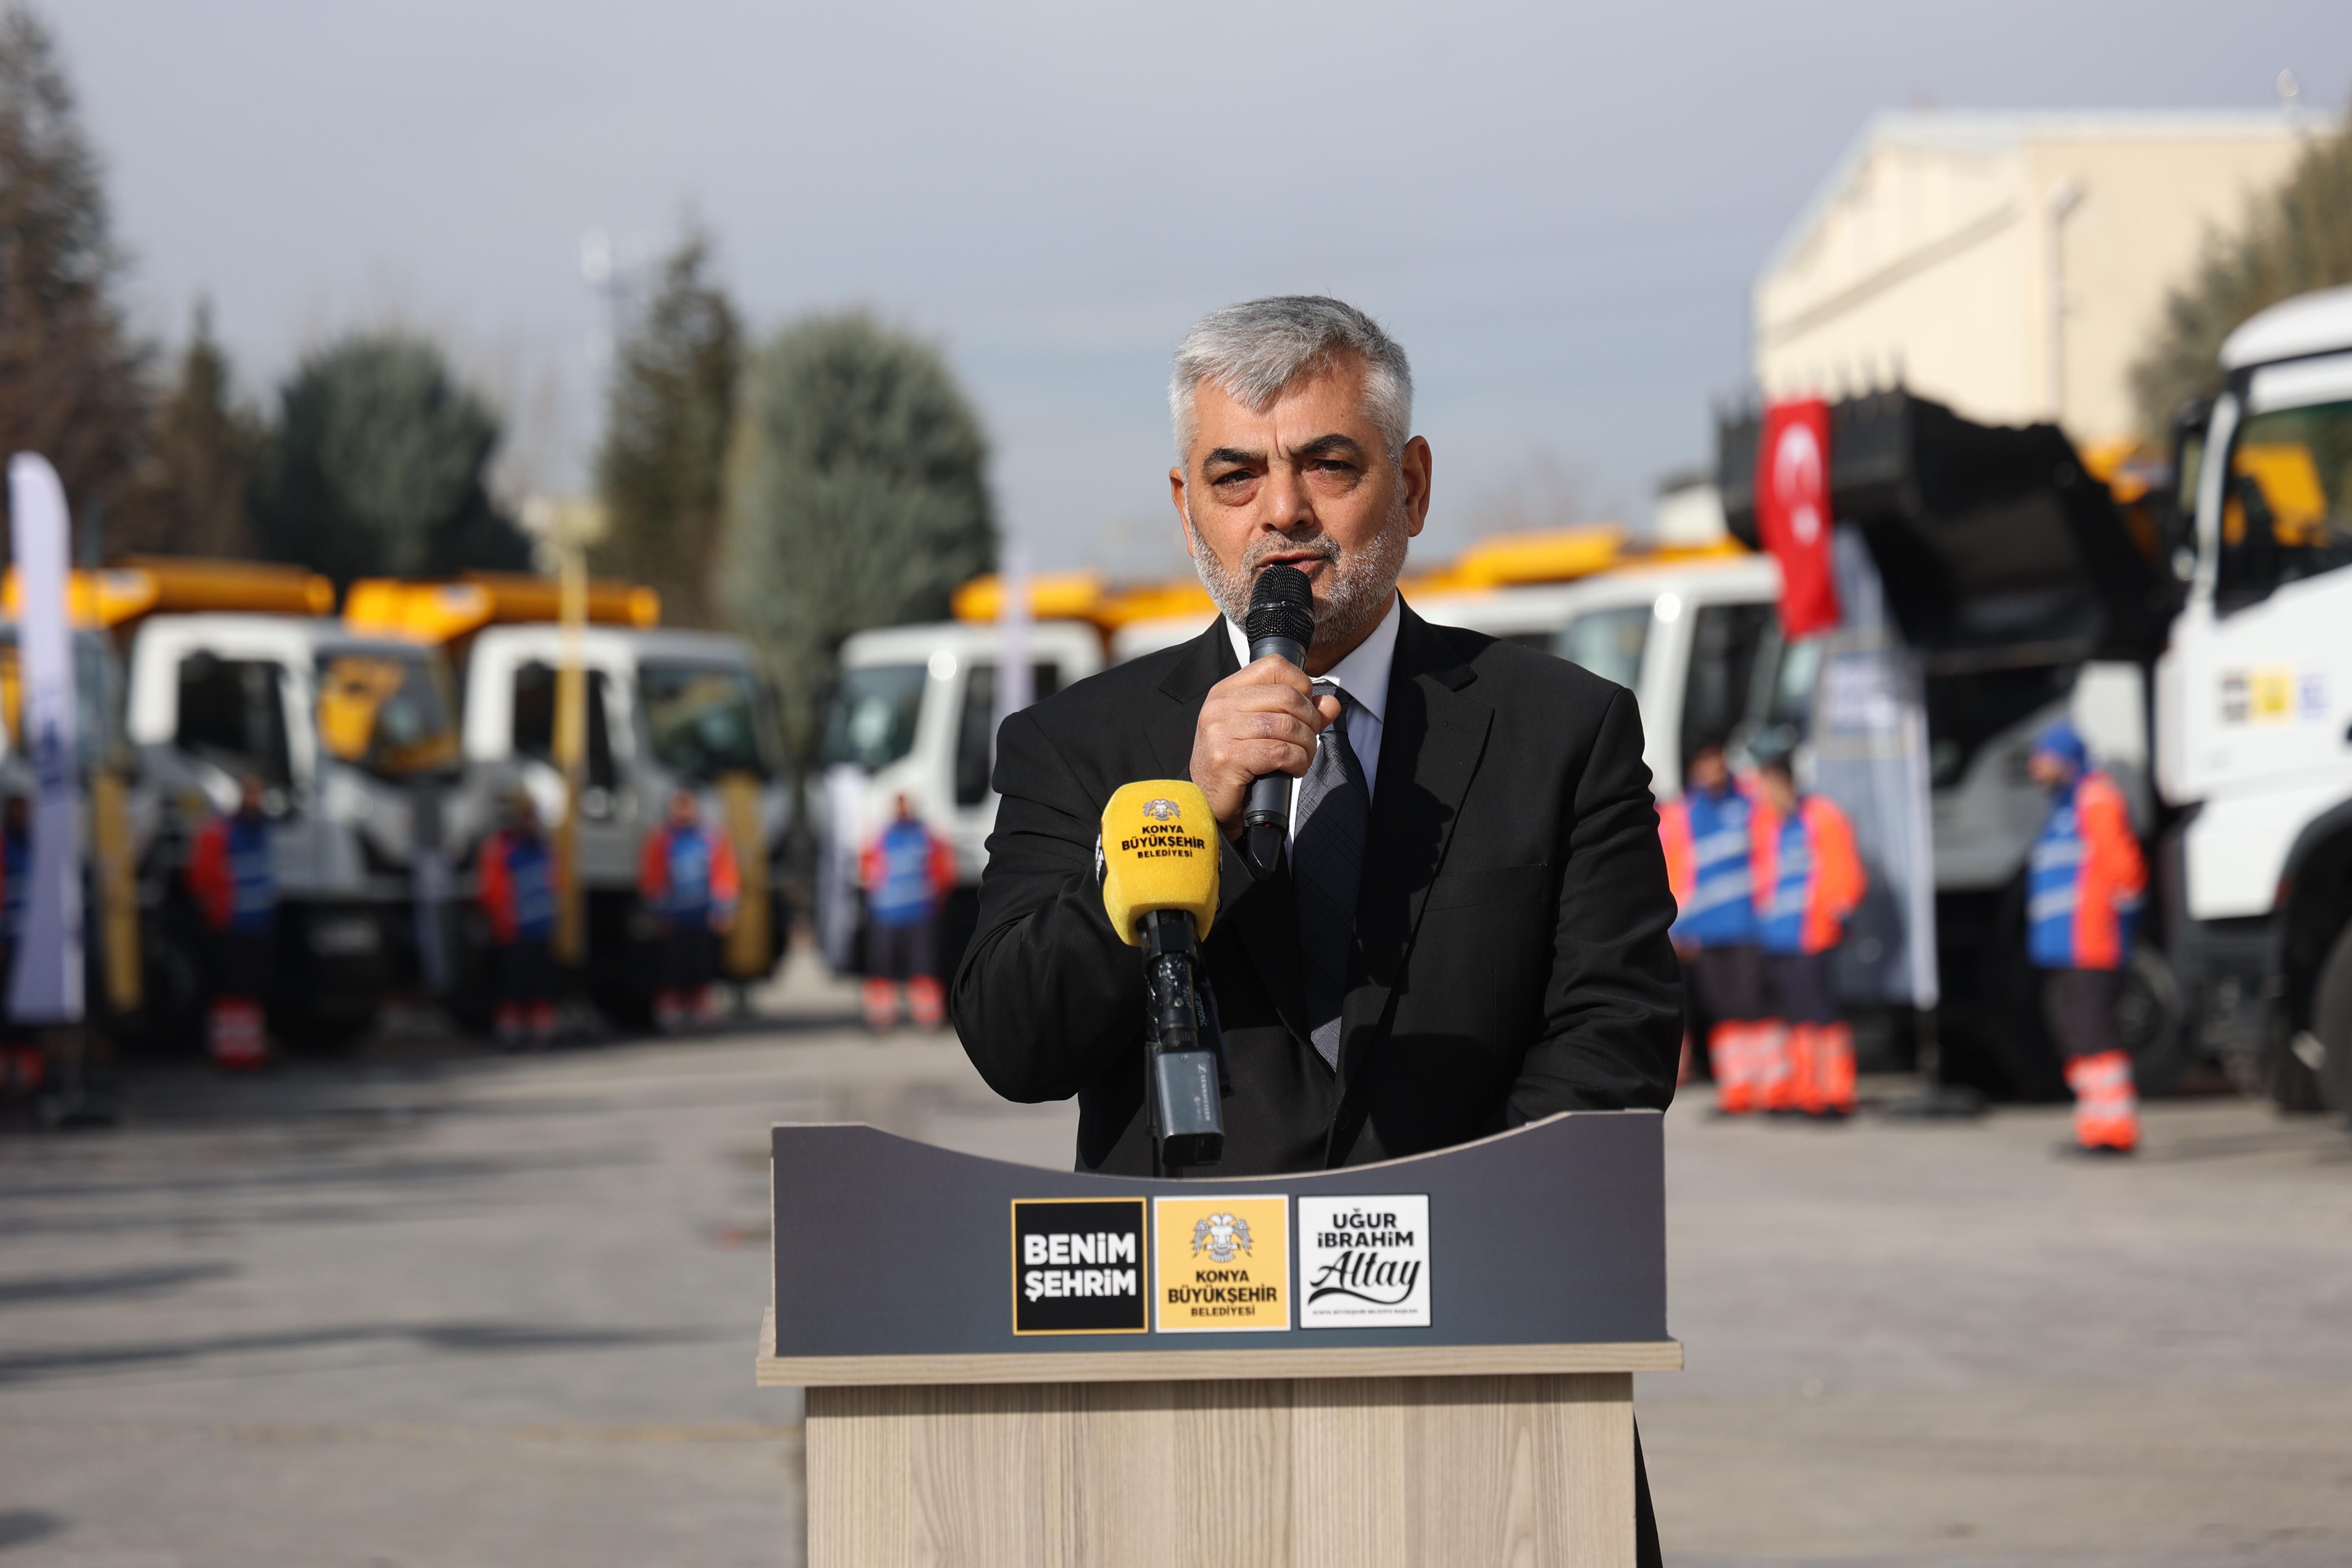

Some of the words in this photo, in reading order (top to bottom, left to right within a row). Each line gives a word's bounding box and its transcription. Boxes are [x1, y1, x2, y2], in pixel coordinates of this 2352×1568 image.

[1142, 825, 1184, 834] KONYA
[1122, 835, 1205, 851] BÜYÜKŞEHİR
[1137, 848, 1193, 858] BELEDİYESİ
[1201, 1074, 1211, 1121] SENNHEISER
[1333, 1208, 1396, 1229] UĞUR
[1196, 1269, 1249, 1282] KONYA
[1308, 1250, 1421, 1306] Altay
[1168, 1284, 1277, 1303] BÜYÜKŞEHİR
[1191, 1305, 1255, 1316] BELEDİYESİ
